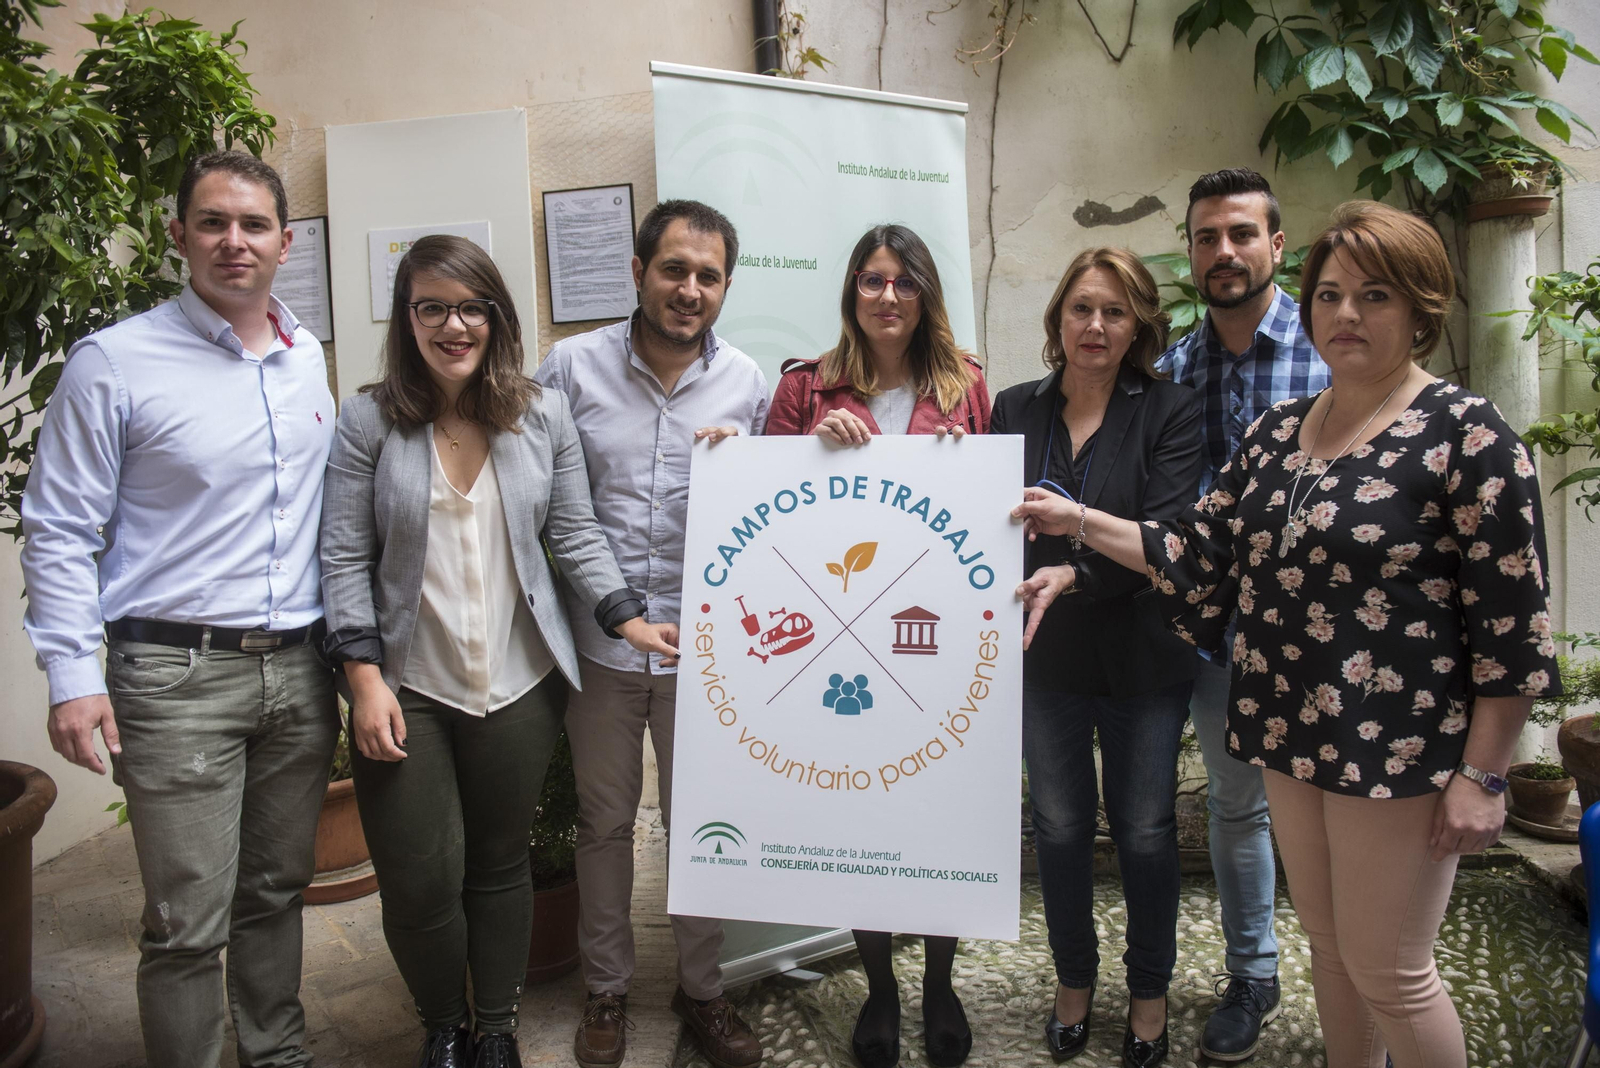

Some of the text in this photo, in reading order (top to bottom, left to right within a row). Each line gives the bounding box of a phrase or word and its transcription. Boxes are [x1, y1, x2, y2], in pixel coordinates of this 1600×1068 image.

[837, 161, 950, 183] Instituto Andaluz de la Juventud
[736, 253, 817, 270] ndaluz de la Juventud
[703, 475, 995, 591] CAMPOS DE TRABAJO
[696, 621, 999, 792] servicio voluntario para jóvenes
[690, 855, 707, 864] JUNTA
[761, 842, 901, 861] Instituto Andaluz de la Juventud
[760, 857, 998, 883] CONSEJERÍA DE IGUALDAD Y POLÍTICAS SOCIALES
